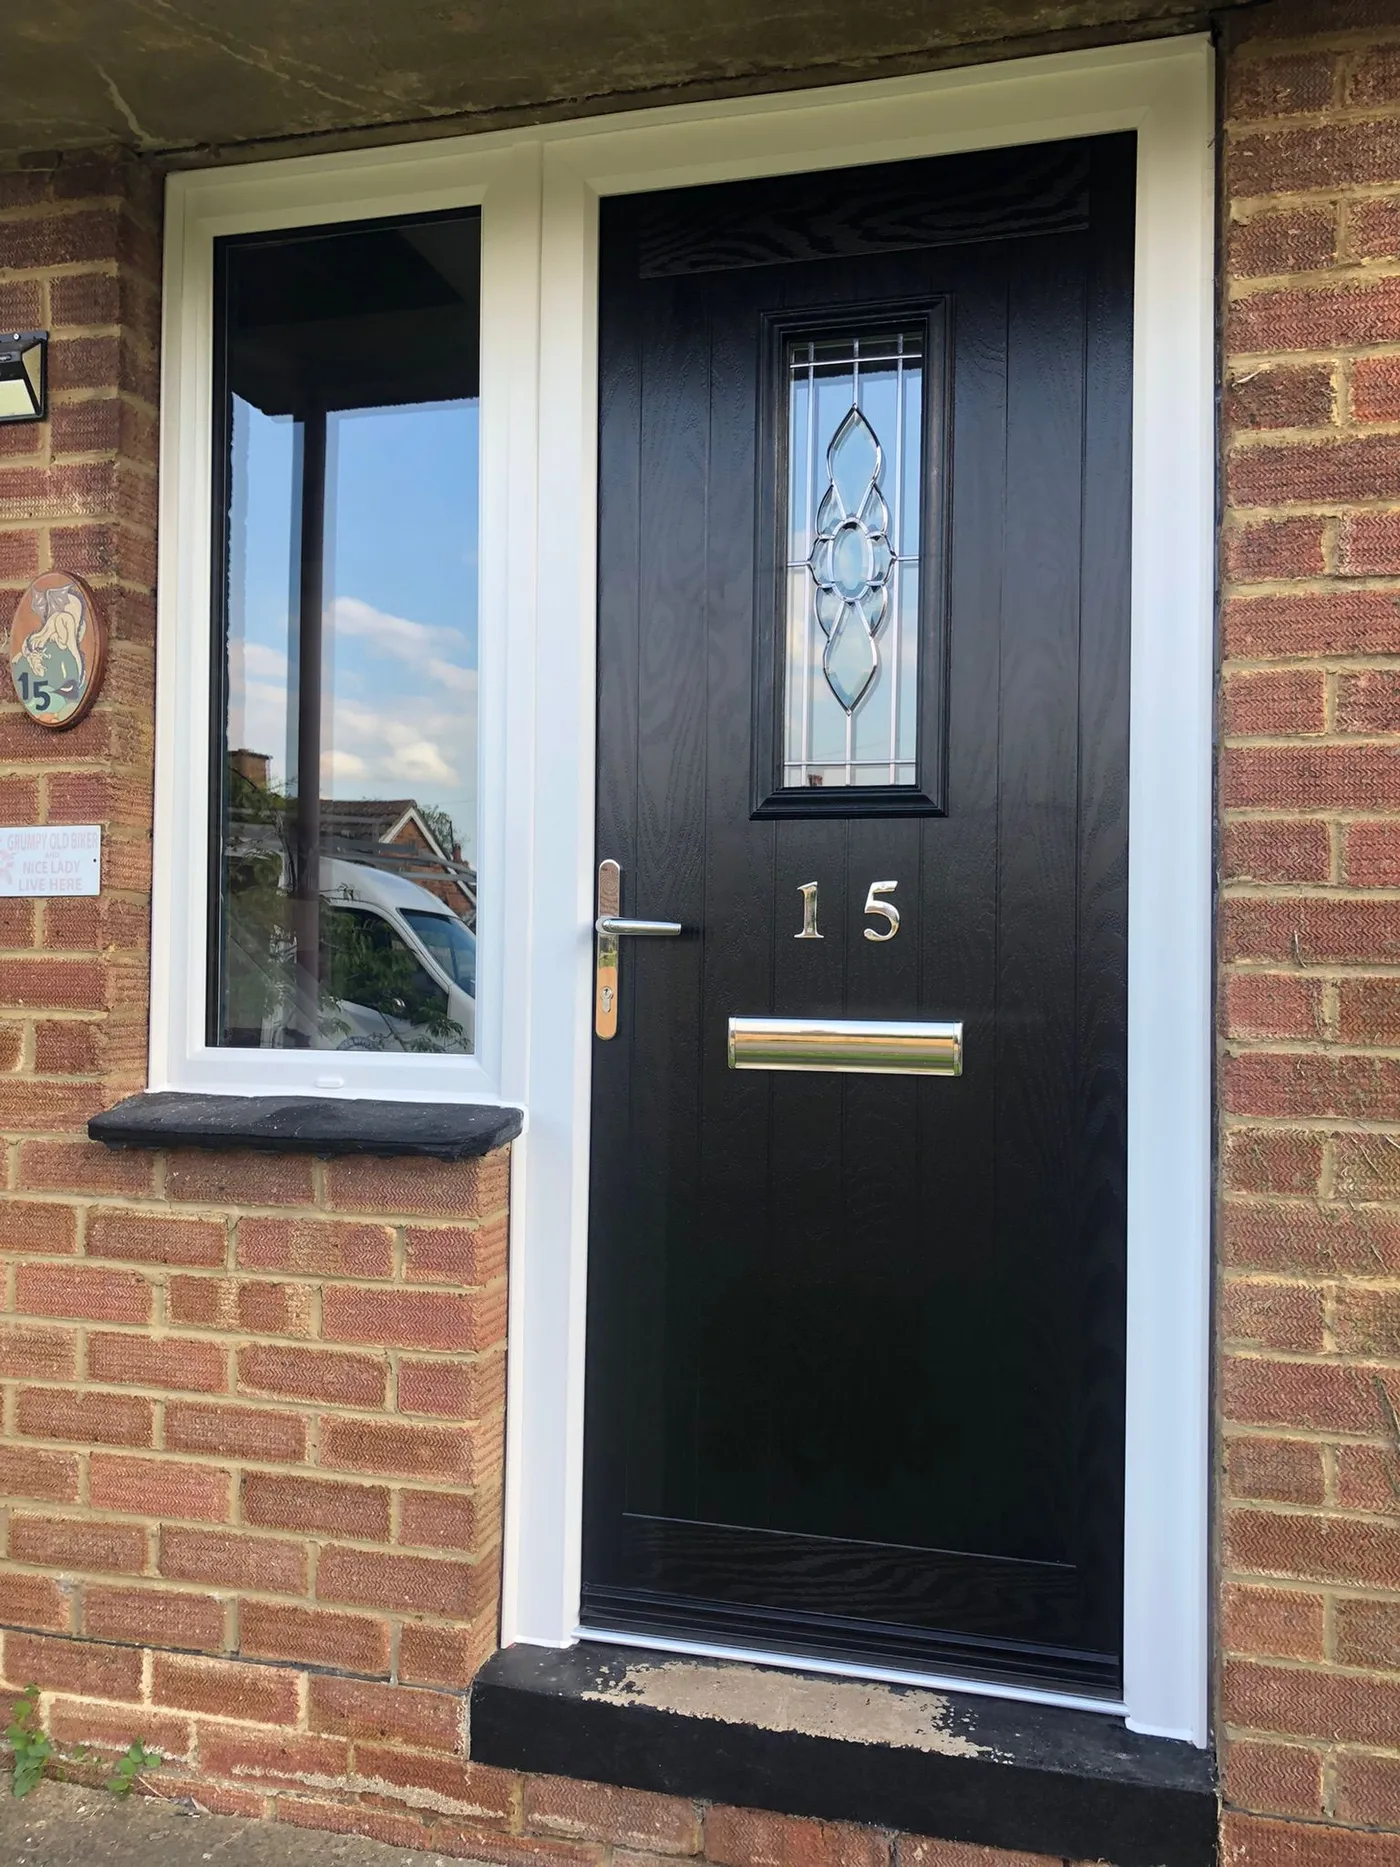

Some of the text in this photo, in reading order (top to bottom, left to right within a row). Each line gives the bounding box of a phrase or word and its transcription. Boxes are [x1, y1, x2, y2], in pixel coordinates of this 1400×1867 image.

[17, 672, 51, 711] 15
[7, 831, 98, 851] GRUMPY OLD BIKER
[23, 860, 80, 874] NICE LADY
[18, 878, 82, 891] LIVE HERE
